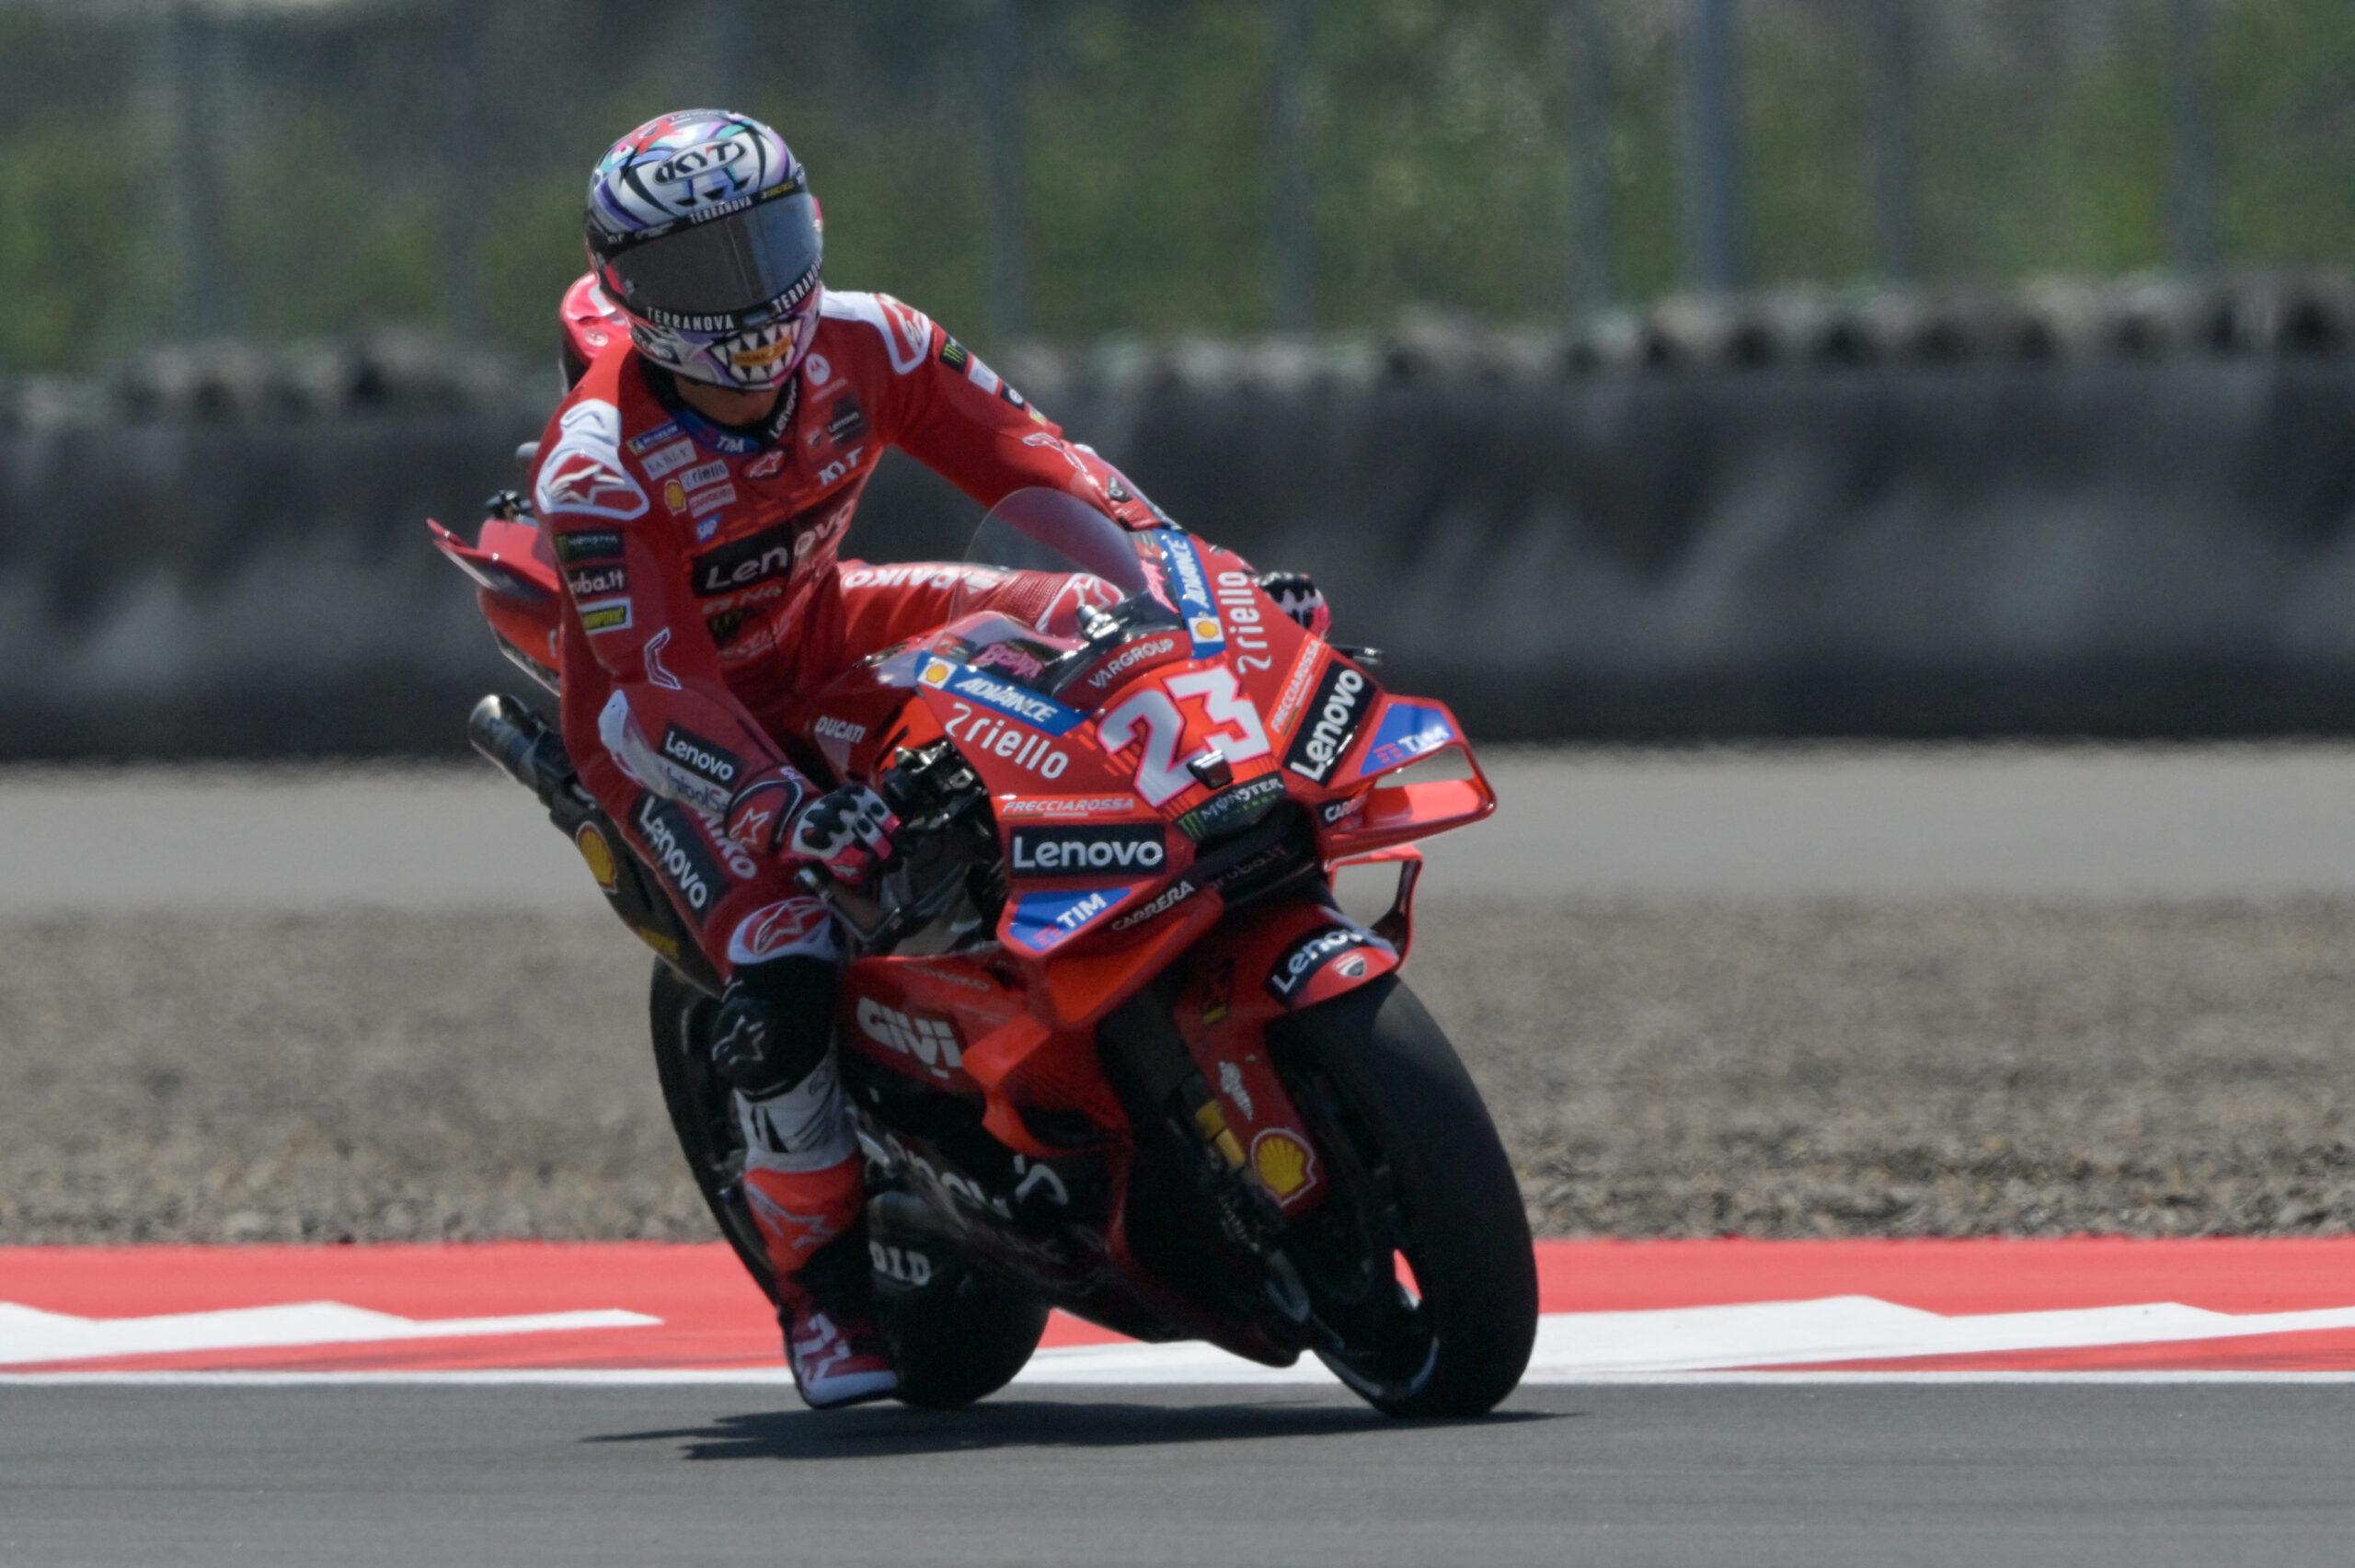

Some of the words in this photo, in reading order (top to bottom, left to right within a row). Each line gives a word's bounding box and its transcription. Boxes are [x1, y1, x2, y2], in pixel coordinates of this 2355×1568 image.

[655, 141, 746, 183] KYT
[690, 196, 753, 224] TERRANOVA
[647, 305, 734, 331] TERRANOVA
[1167, 538, 1210, 609] ADVANCE
[955, 677, 1059, 723] ADVANCE
[1270, 638, 1322, 733] FRECCIAROSSA
[814, 715, 867, 743] DUCATI
[1097, 664, 1271, 808] 23
[1290, 669, 1363, 782] Lenovo
[665, 730, 734, 781] Lenovo
[1003, 797, 1134, 813] FRECCIAROSSA
[1200, 777, 1285, 820] MONSTER
[639, 795, 707, 910] Lenovo
[1014, 836, 1163, 868] Lenovo
[1056, 892, 1108, 928] TIM
[1111, 880, 1195, 931] CARRERA
